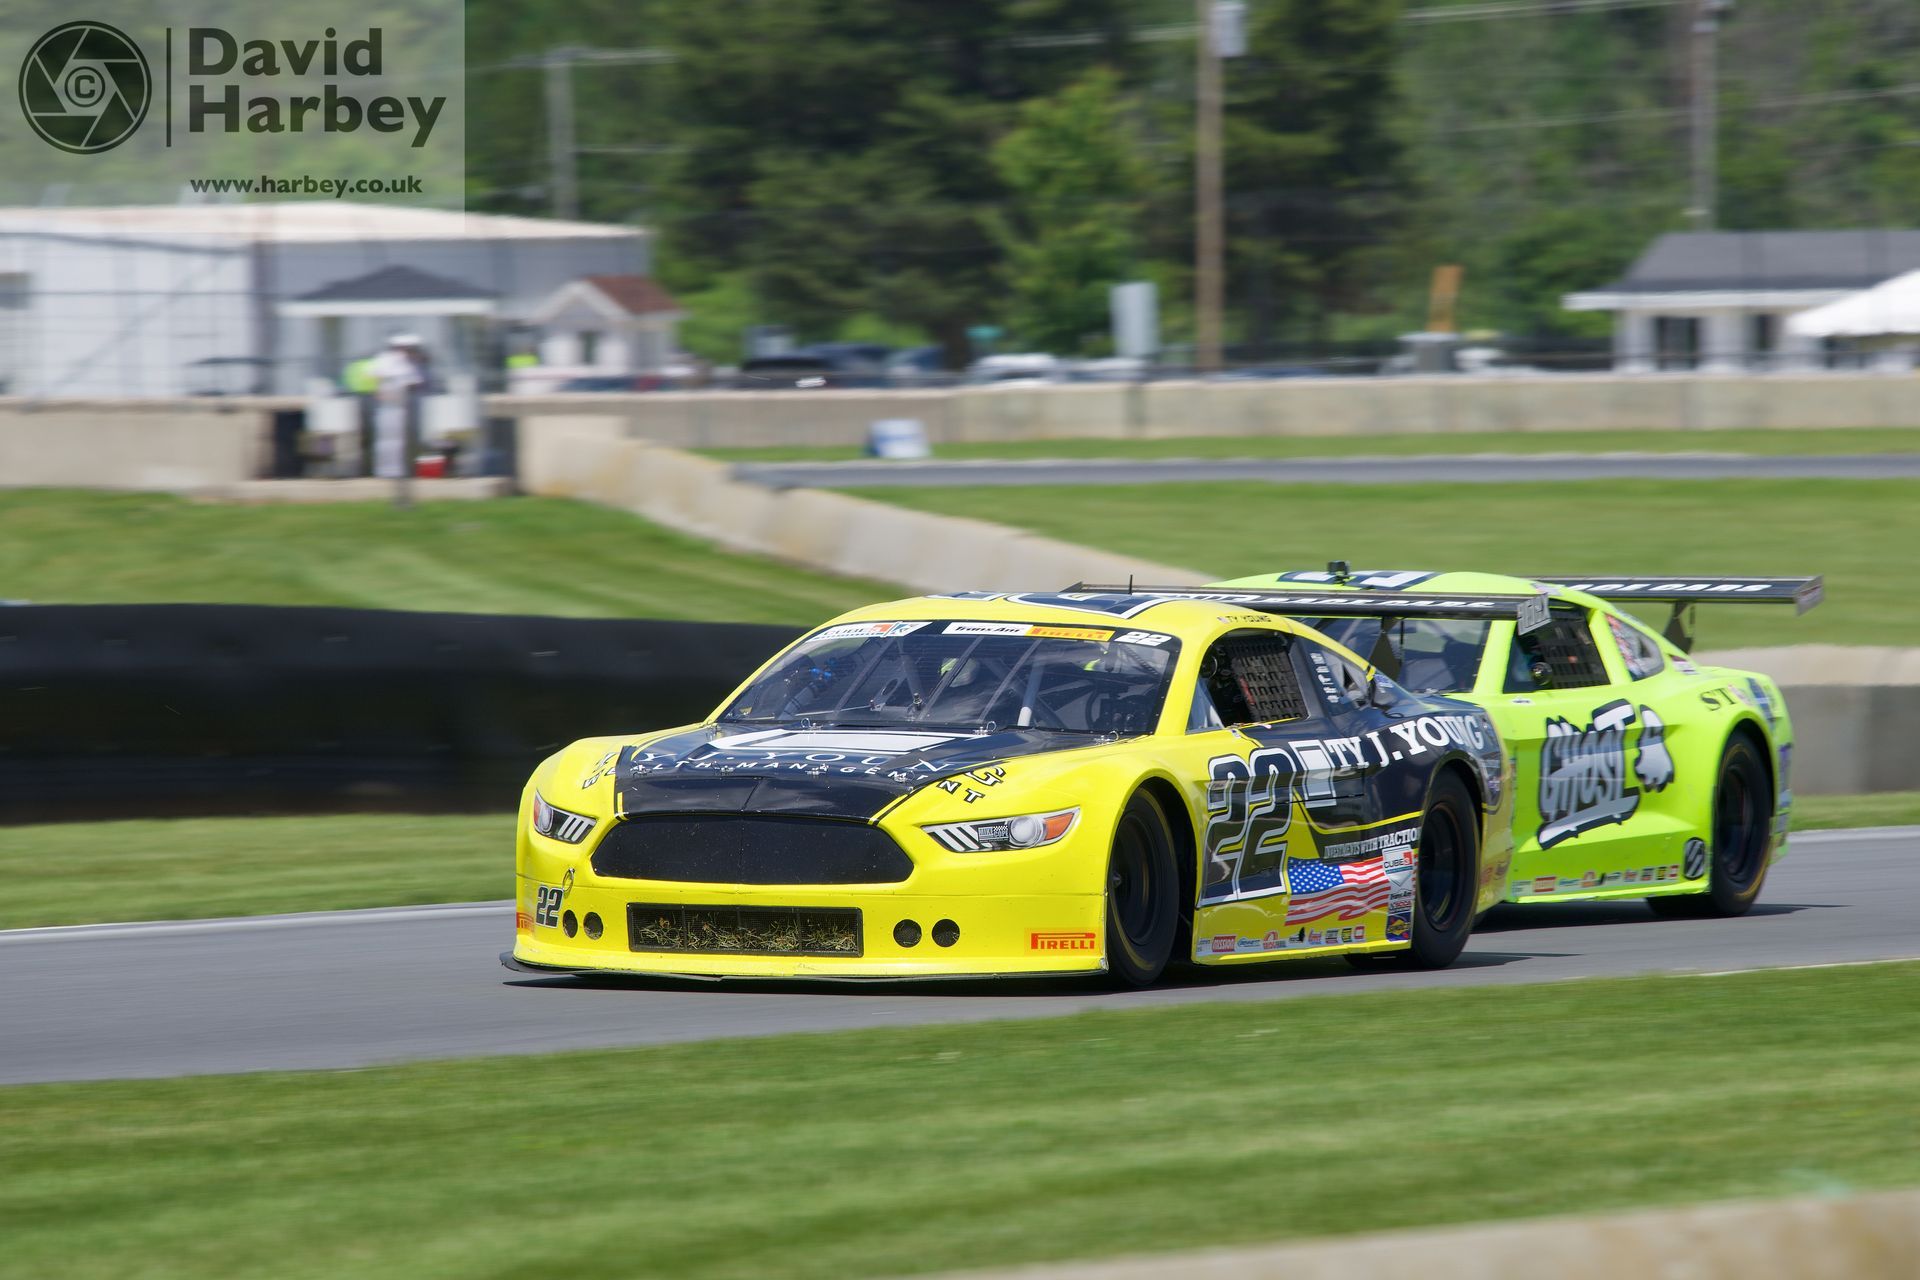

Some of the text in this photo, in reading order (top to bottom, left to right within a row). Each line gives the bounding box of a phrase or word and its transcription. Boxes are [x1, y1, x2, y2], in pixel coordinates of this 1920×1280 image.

[1118, 631, 1172, 647] 22
[1323, 736, 1370, 769] TY
[1195, 748, 1298, 909] 22
[535, 883, 564, 929] 22
[1031, 932, 1096, 950] PIRELLI
